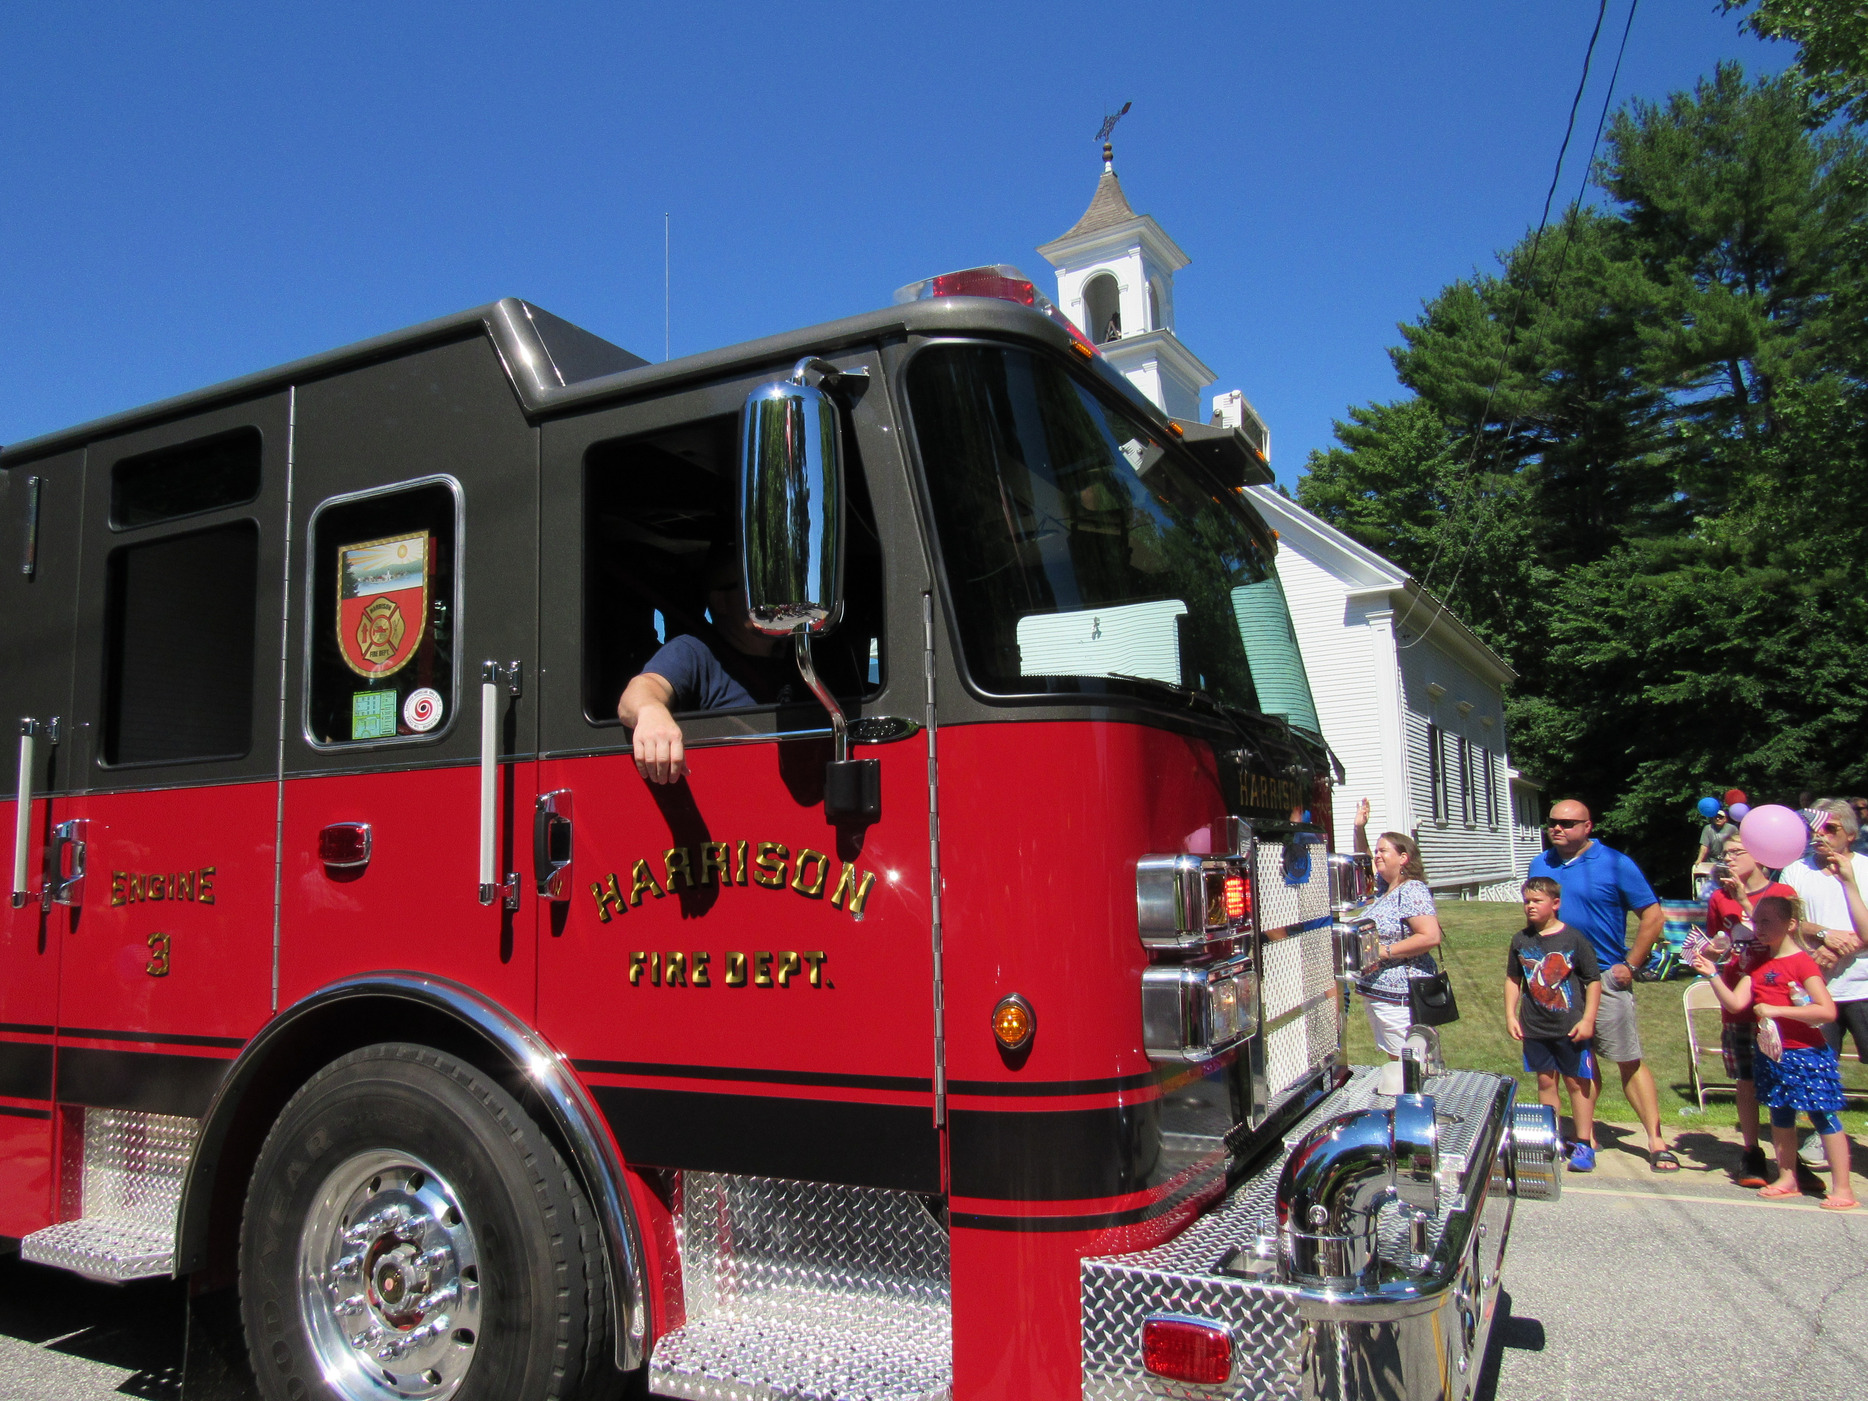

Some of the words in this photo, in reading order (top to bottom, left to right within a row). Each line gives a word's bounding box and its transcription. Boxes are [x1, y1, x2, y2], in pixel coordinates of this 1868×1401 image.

[369, 603, 392, 614] HARRISON
[111, 866, 216, 907] ENGINE
[589, 839, 876, 922] HARRISON
[146, 932, 171, 977] 3
[629, 951, 710, 987] FIRE
[725, 951, 835, 989] DEPT.
